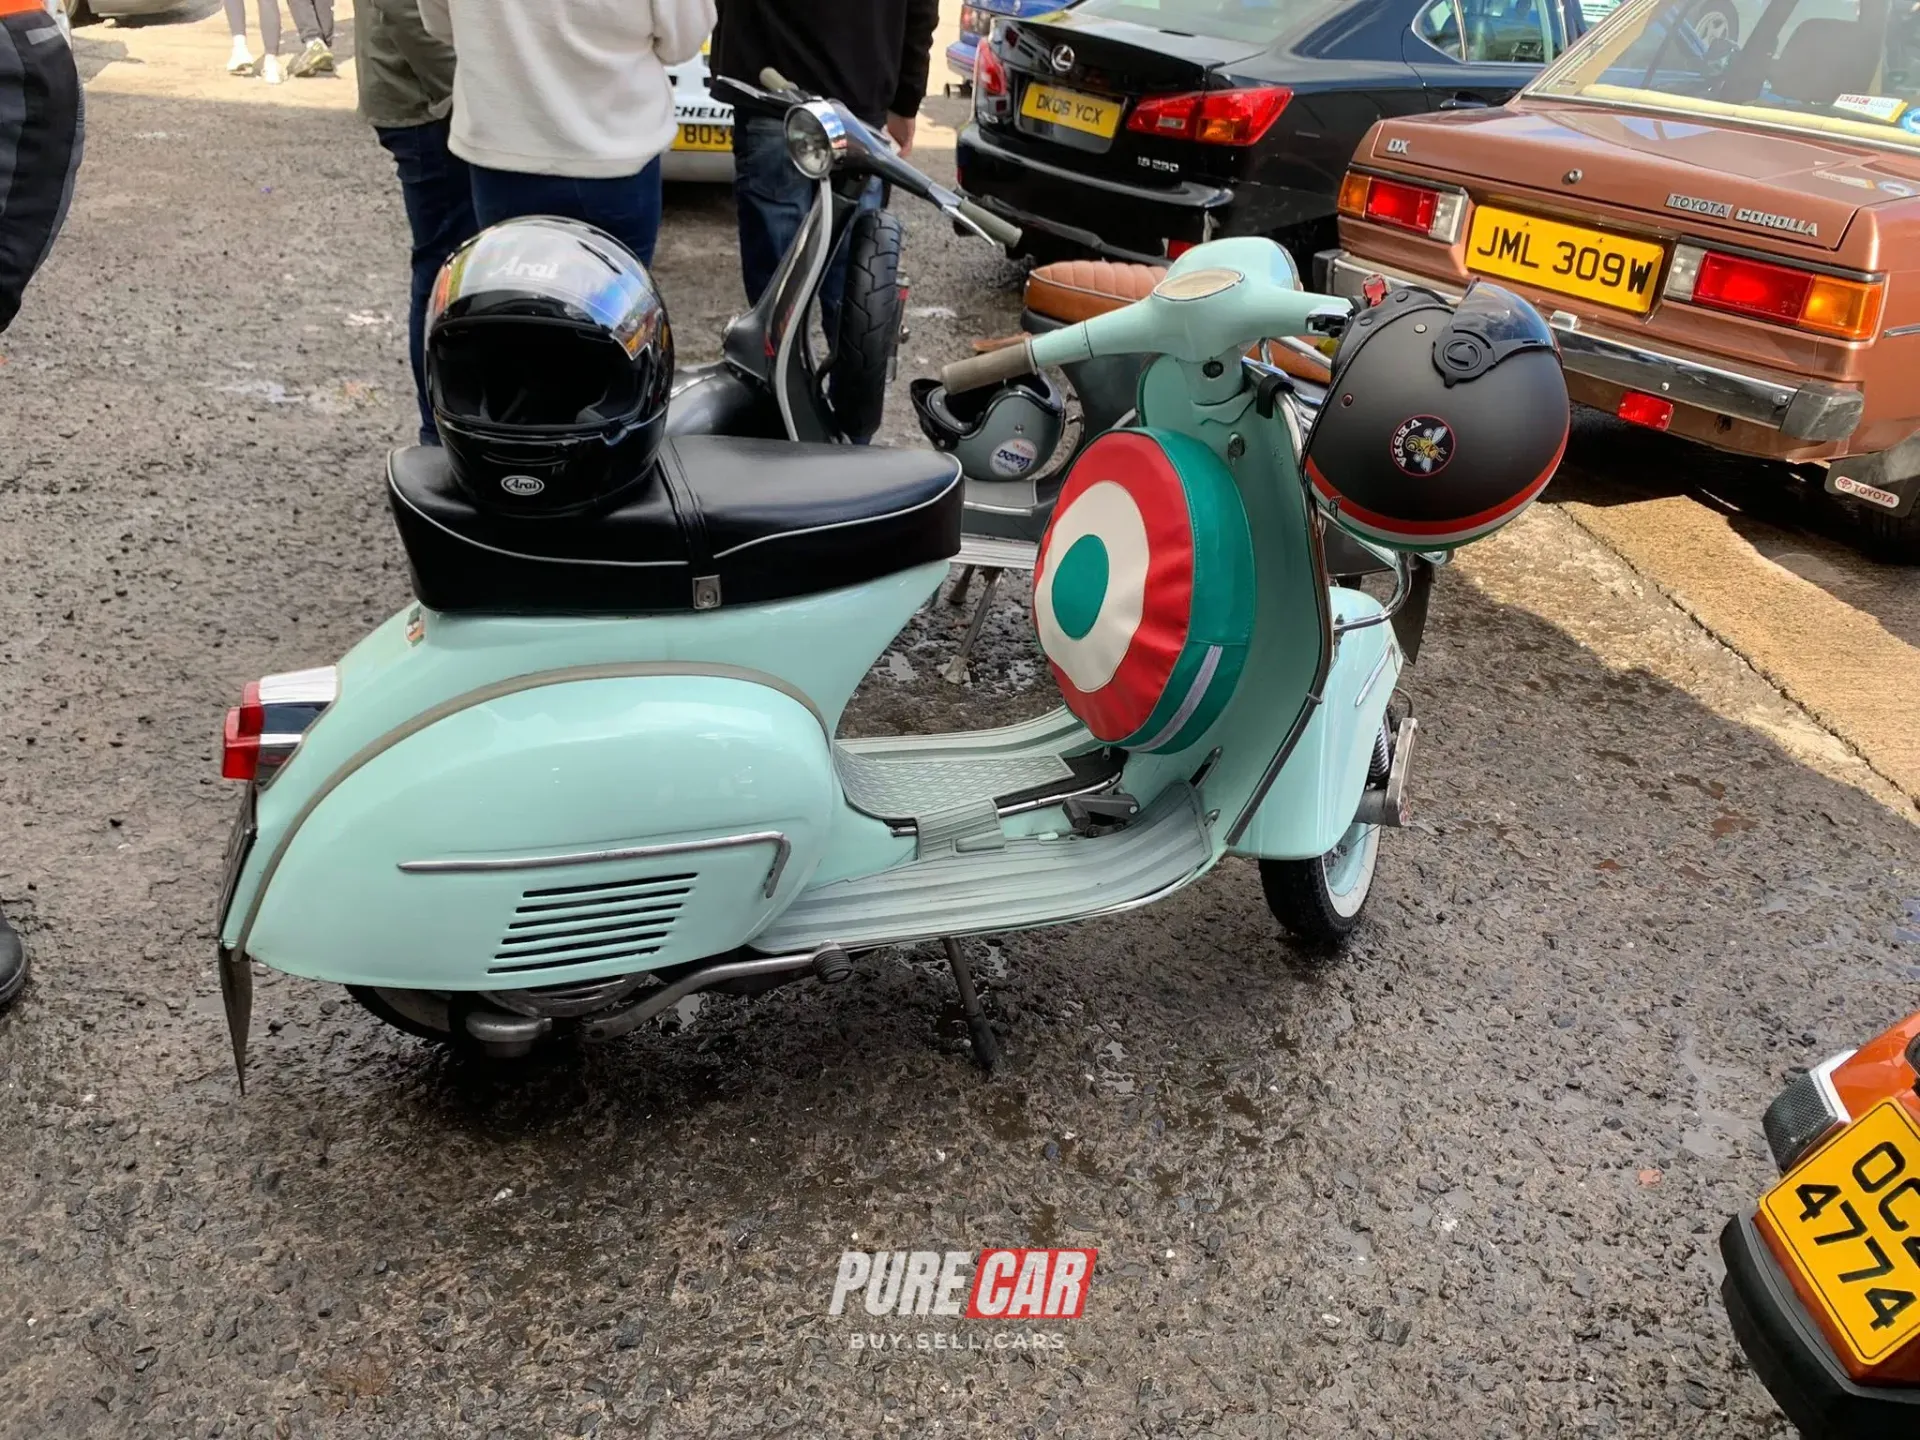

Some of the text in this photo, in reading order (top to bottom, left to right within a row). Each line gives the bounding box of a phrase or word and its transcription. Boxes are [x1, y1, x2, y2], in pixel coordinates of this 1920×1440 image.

[1075, 101, 1104, 126] YCX
[1387, 138, 1411, 155] DX
[1672, 195, 1818, 237] TOYOTA COROLLA
[487, 256, 559, 279] Arai
[1477, 226, 1653, 295] JML 309W
[506, 478, 540, 491] Arai
[1854, 484, 1894, 504] TOYOTA
[1852, 1141, 1920, 1270] OC
[1795, 1183, 1917, 1332] 4774
